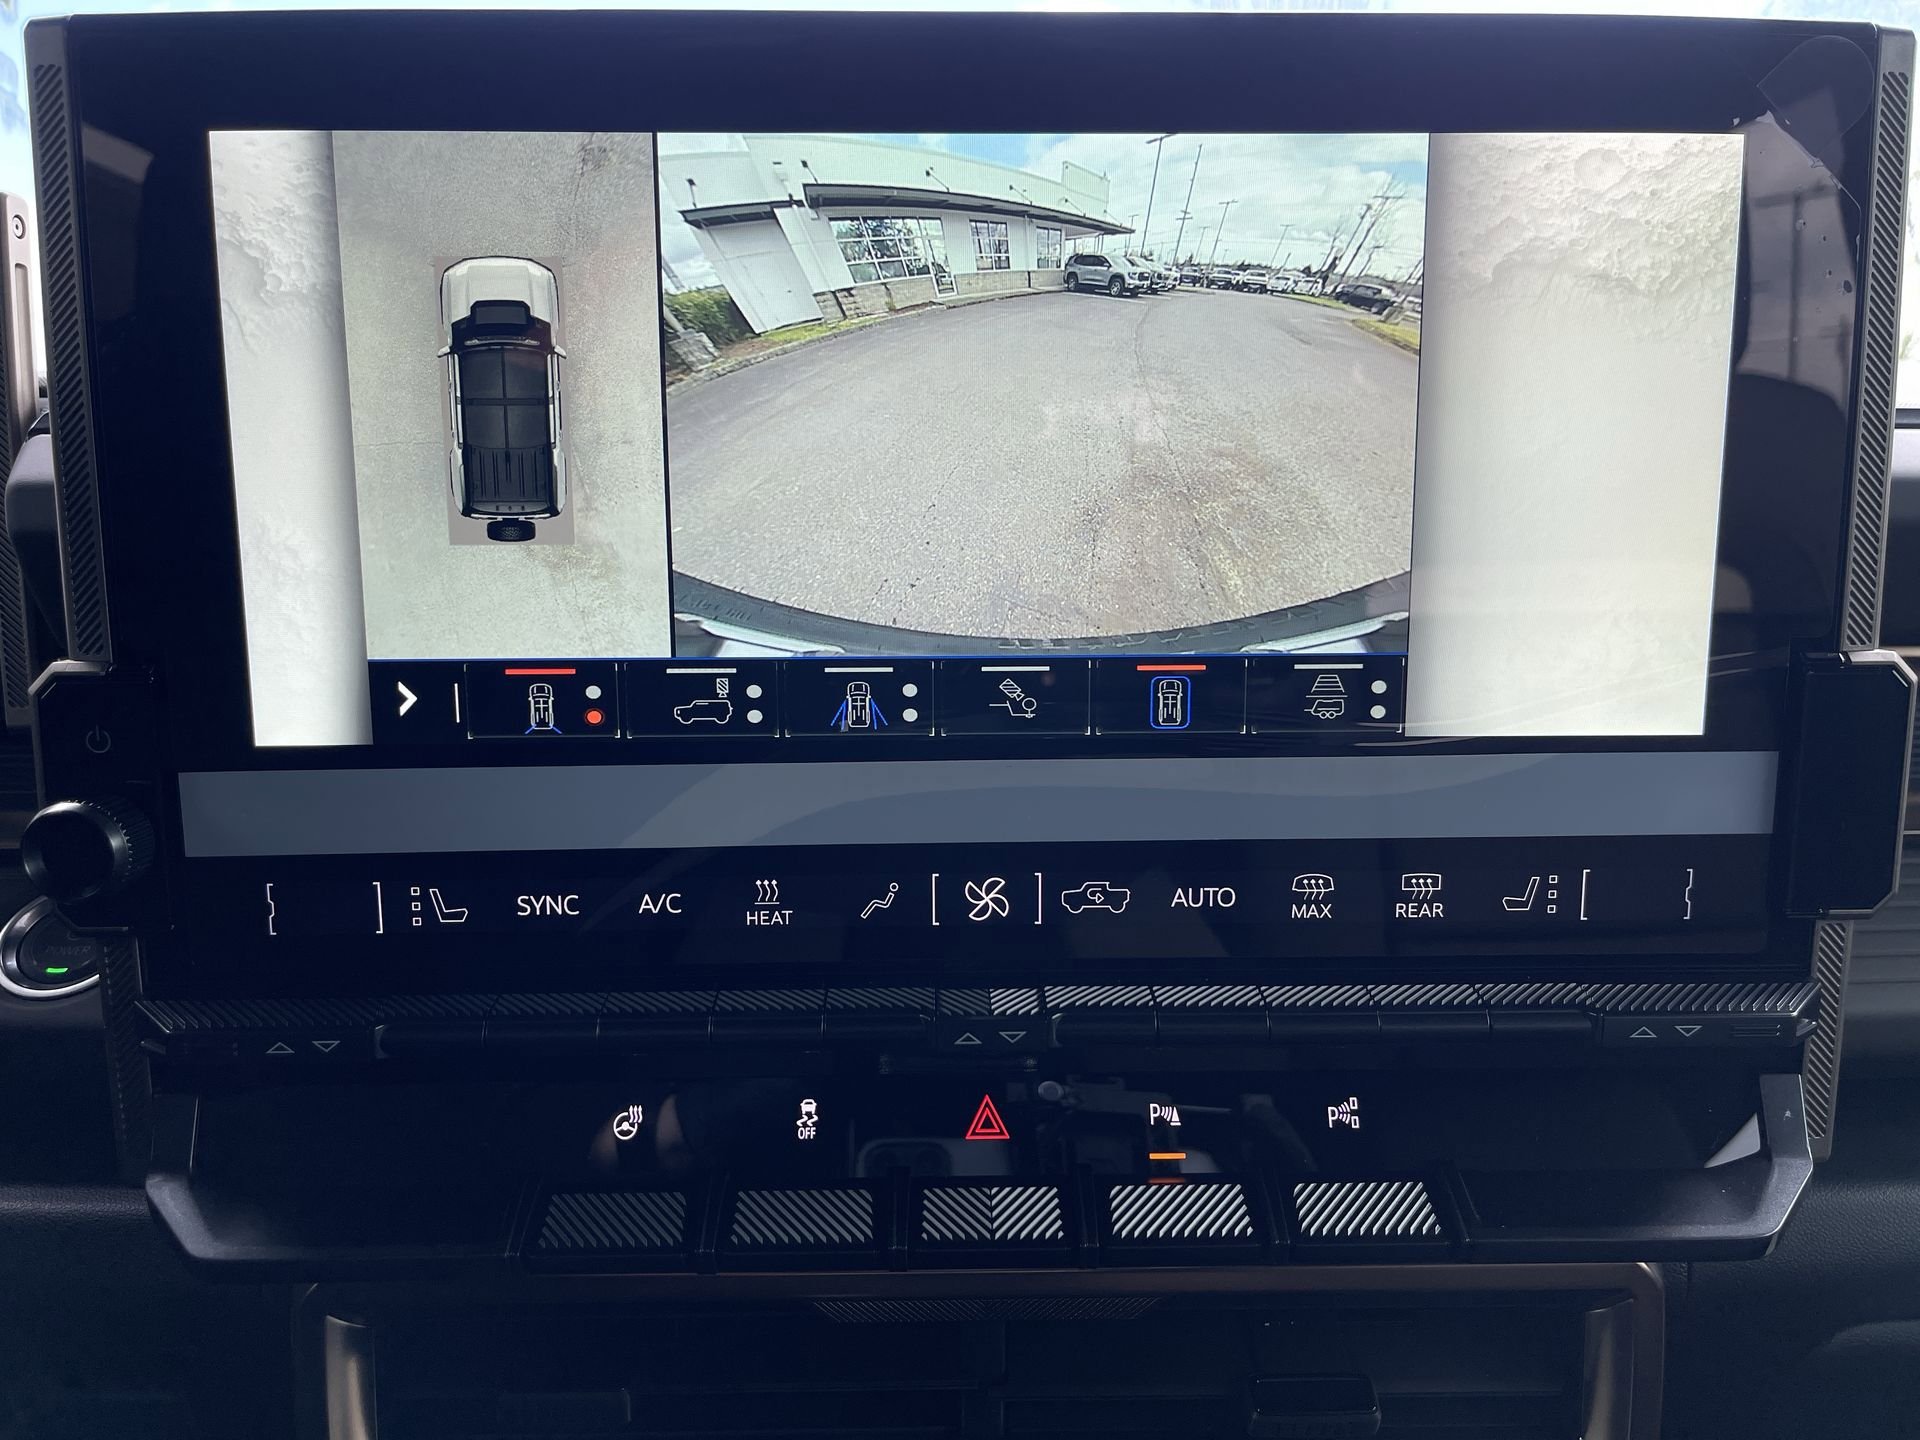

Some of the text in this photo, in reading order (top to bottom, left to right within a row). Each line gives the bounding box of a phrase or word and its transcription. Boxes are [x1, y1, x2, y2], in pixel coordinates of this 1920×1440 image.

[517, 894, 580, 916] SYNC
[639, 894, 682, 914] A/C
[1171, 888, 1236, 908] AUTO
[746, 910, 794, 926] HEAT
[1292, 903, 1332, 919] MAX
[1395, 903, 1444, 918] REAR
[797, 1126, 817, 1140] OFF
